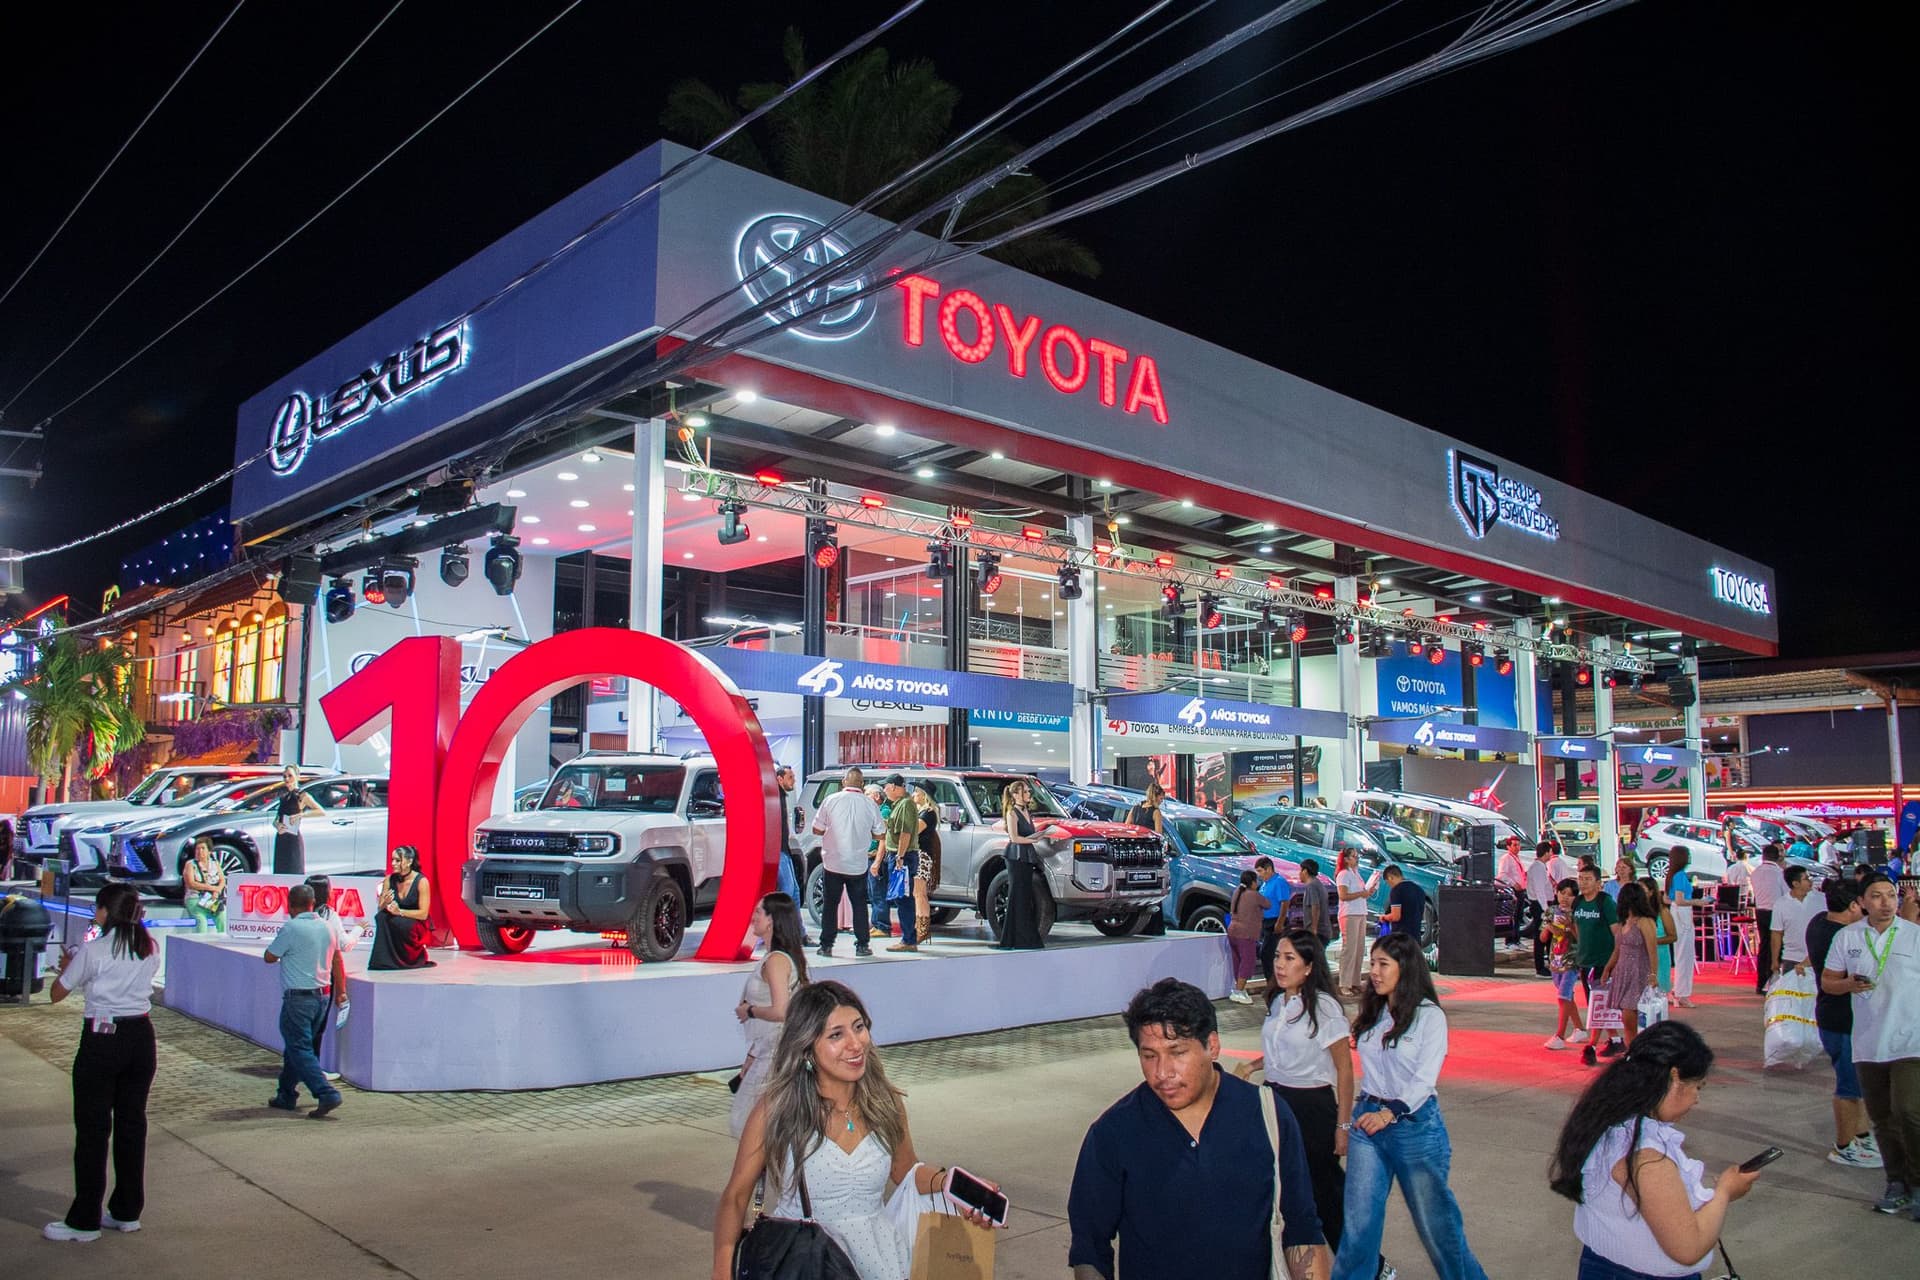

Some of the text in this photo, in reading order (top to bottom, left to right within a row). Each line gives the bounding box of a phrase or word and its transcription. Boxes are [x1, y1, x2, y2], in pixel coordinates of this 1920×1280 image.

[888, 268, 1169, 424] TOYOTA
[311, 319, 464, 440] LEXUS
[1500, 479, 1542, 507] GRUPO
[1716, 568, 1771, 614] TOYOSA
[797, 659, 949, 698] 45 AÑOS TOYOSA
[1411, 679, 1446, 695] TOYOTA
[1017, 715, 1039, 724] DESDE
[1177, 697, 1270, 728] 45 AÑOS TOYOSA
[1391, 700, 1418, 714] VAMOS
[1131, 723, 1160, 735] TOYOSA
[1168, 724, 1199, 736] EMPRESA
[1200, 727, 1235, 737] BOLIVIANA
[1236, 730, 1251, 739] PARA
[319, 627, 781, 961] 10
[511, 838, 545, 847] TOYOTA
[239, 885, 365, 917] TOTA
[230, 924, 248, 932] HASTA
[257, 924, 275, 933] AÑOS
